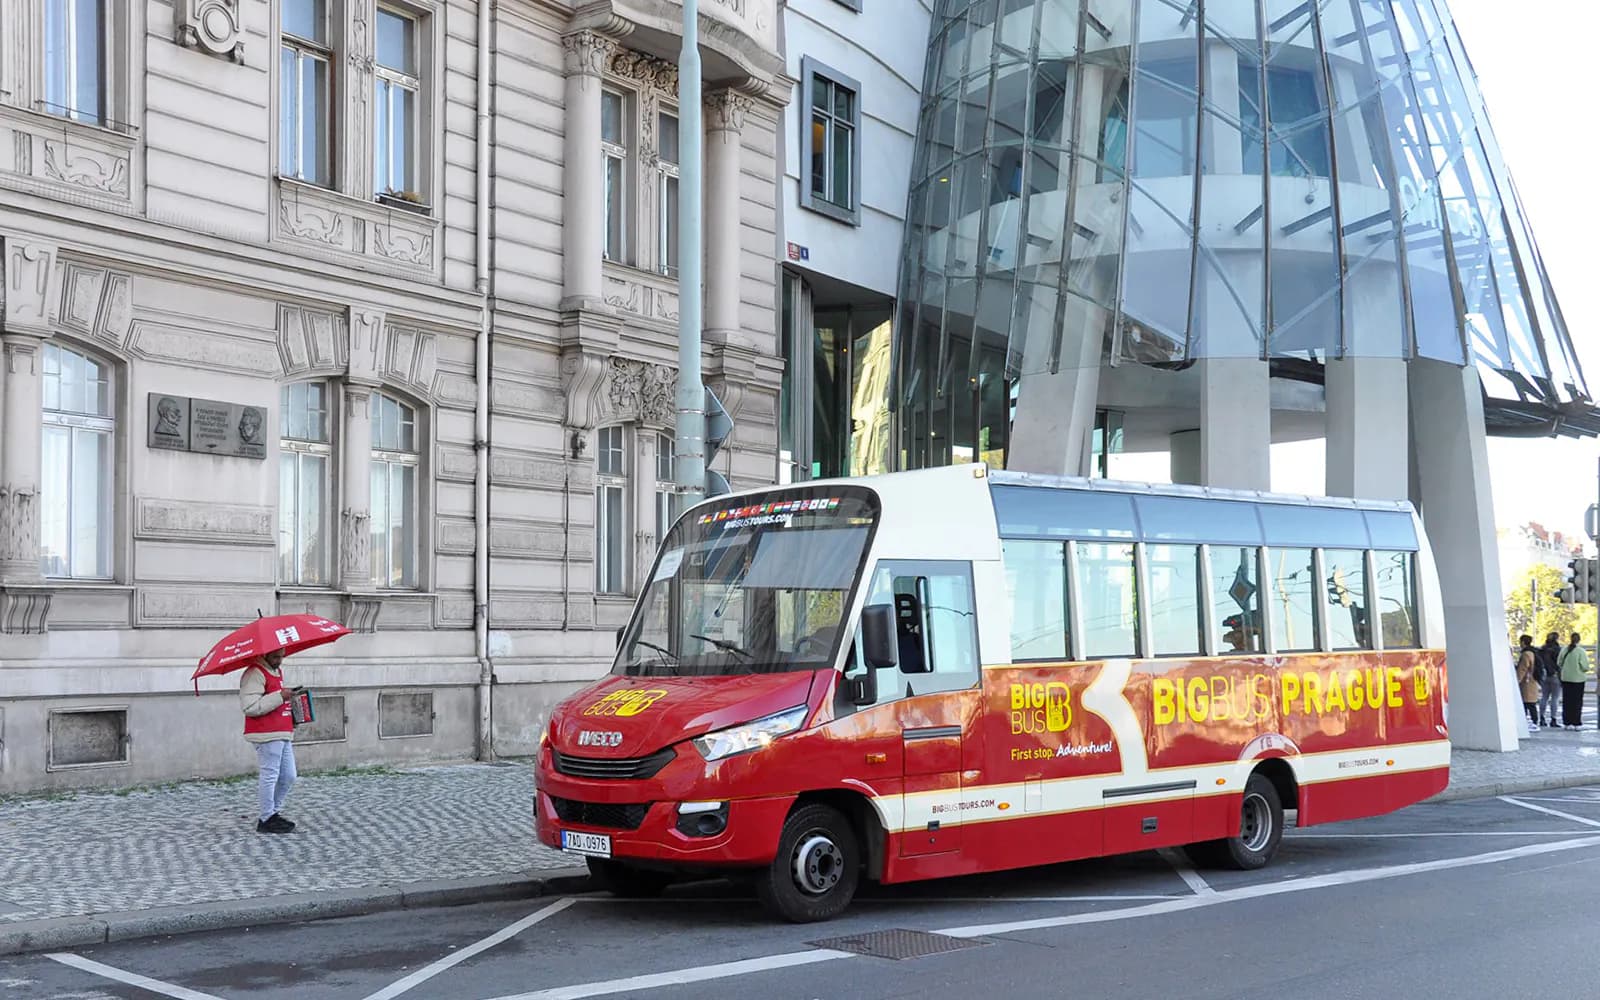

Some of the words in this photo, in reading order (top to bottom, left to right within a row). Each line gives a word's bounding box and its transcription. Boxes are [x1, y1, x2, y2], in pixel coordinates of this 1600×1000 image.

[724, 513, 793, 529] BIGBUSTOURS.COM
[600, 689, 645, 701] BIG
[1010, 683, 1045, 709] BIG
[1281, 667, 1403, 716] PRAGUE
[584, 701, 624, 716] BUS
[1011, 710, 1046, 734] BUS
[577, 731, 623, 747] IVECO
[1010, 748, 1032, 760] First
[1056, 741, 1112, 758] Adventure!
[932, 799, 995, 813] BIGBUSTOURS.COM
